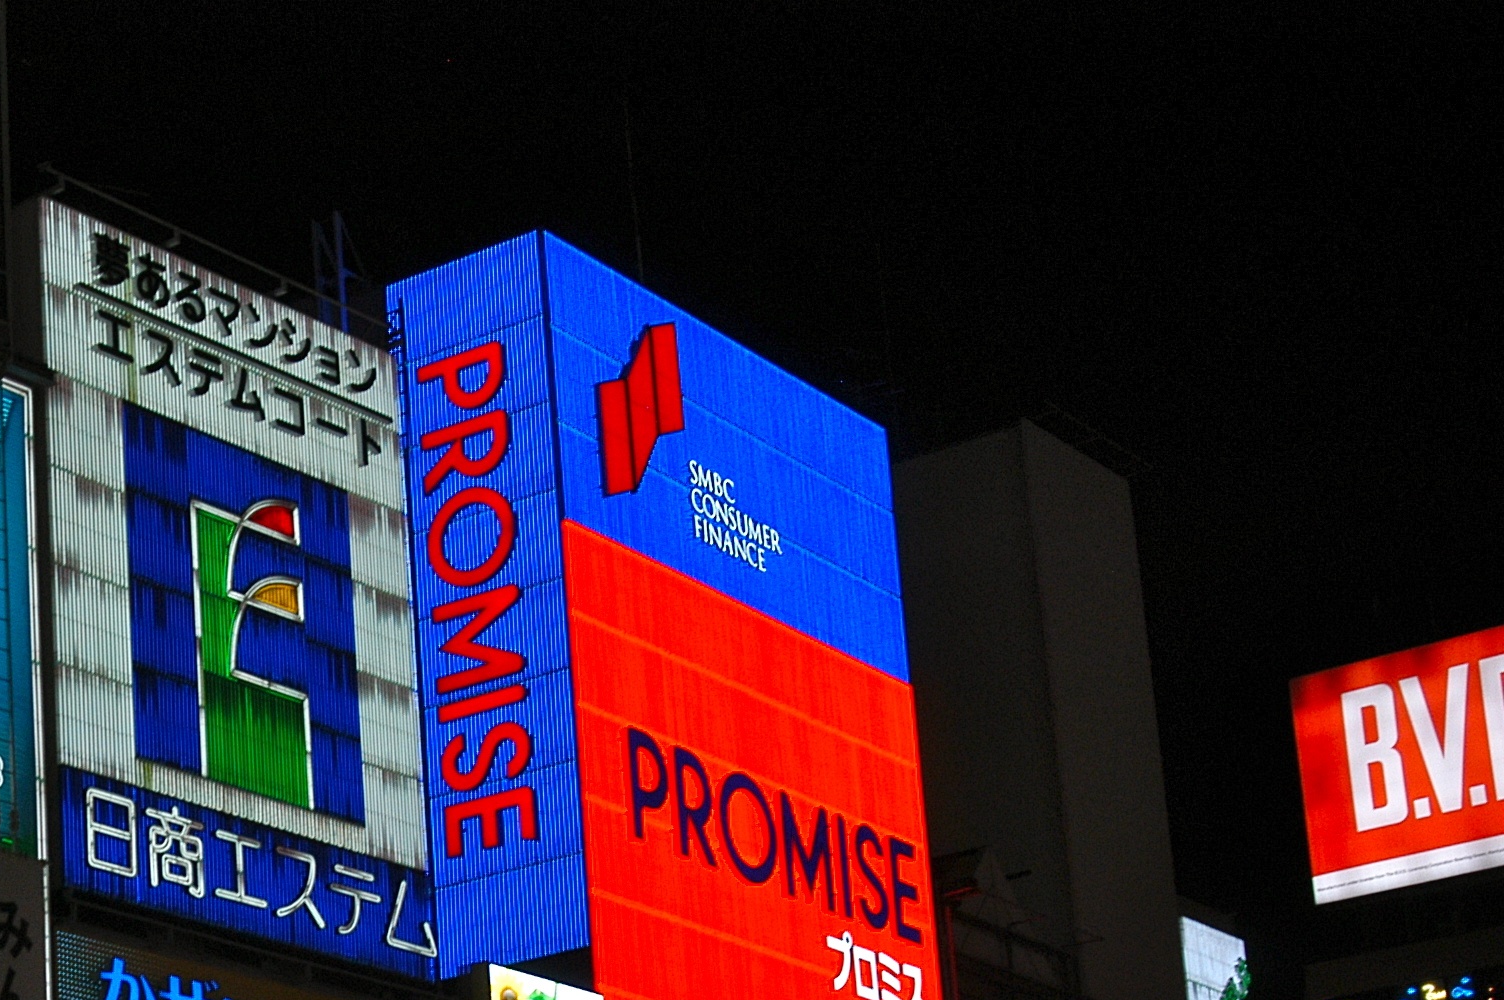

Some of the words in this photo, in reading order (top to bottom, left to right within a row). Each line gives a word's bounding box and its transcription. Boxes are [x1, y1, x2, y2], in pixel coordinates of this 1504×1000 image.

[88, 233, 379, 393] 夢あるマンション
[99, 309, 383, 469] エステムコート
[689, 459, 736, 504] SMBC
[691, 487, 783, 555] CONSUMER
[694, 513, 767, 572] FINANCE
[417, 340, 538, 860] PROMISE
[86, 785, 439, 960] 日商エステム
[626, 726, 926, 948] PROMISE
